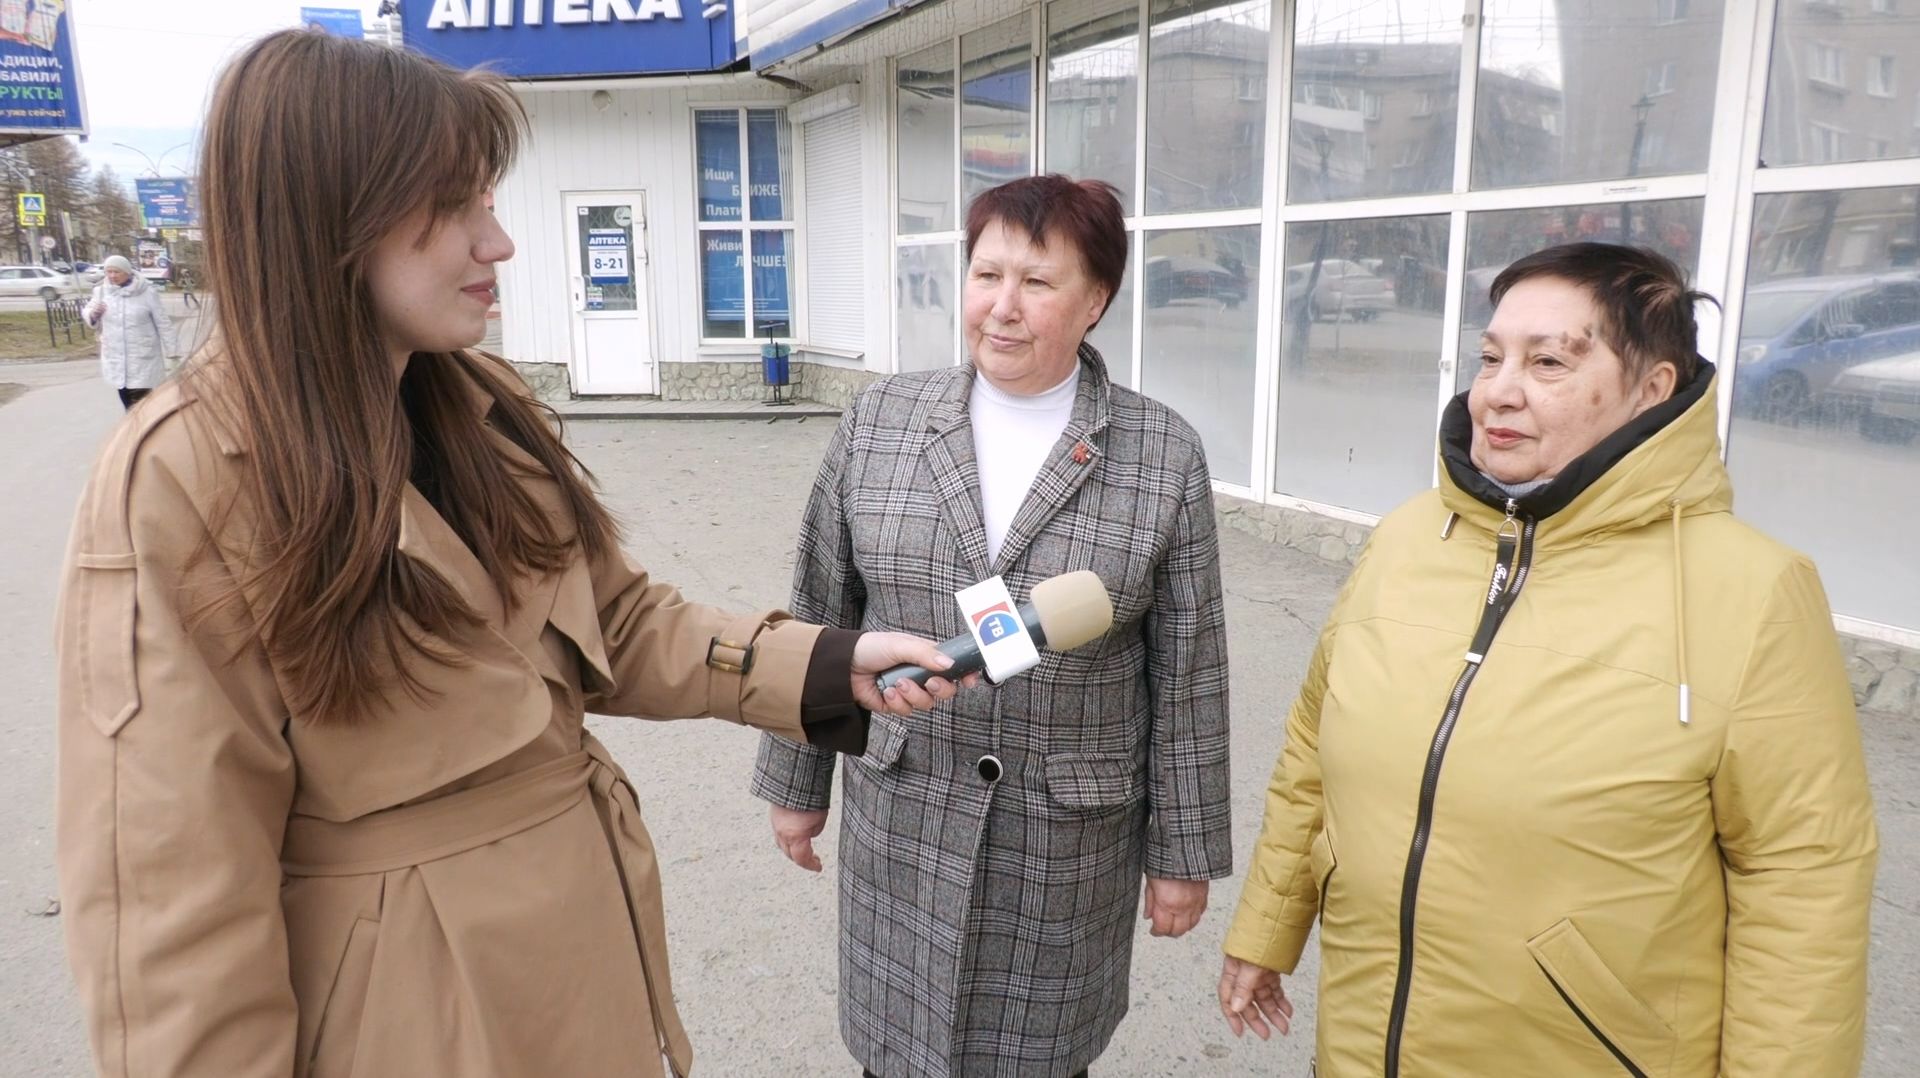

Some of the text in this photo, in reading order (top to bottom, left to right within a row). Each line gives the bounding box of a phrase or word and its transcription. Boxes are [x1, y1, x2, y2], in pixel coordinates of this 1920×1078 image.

[705, 167, 734, 182] Ищи
[589, 236, 626, 245] АПТЕКА
[706, 239, 743, 251] Живи
[594, 258, 624, 270] 8-21
[734, 255, 786, 267] ЛЧШЕ!
